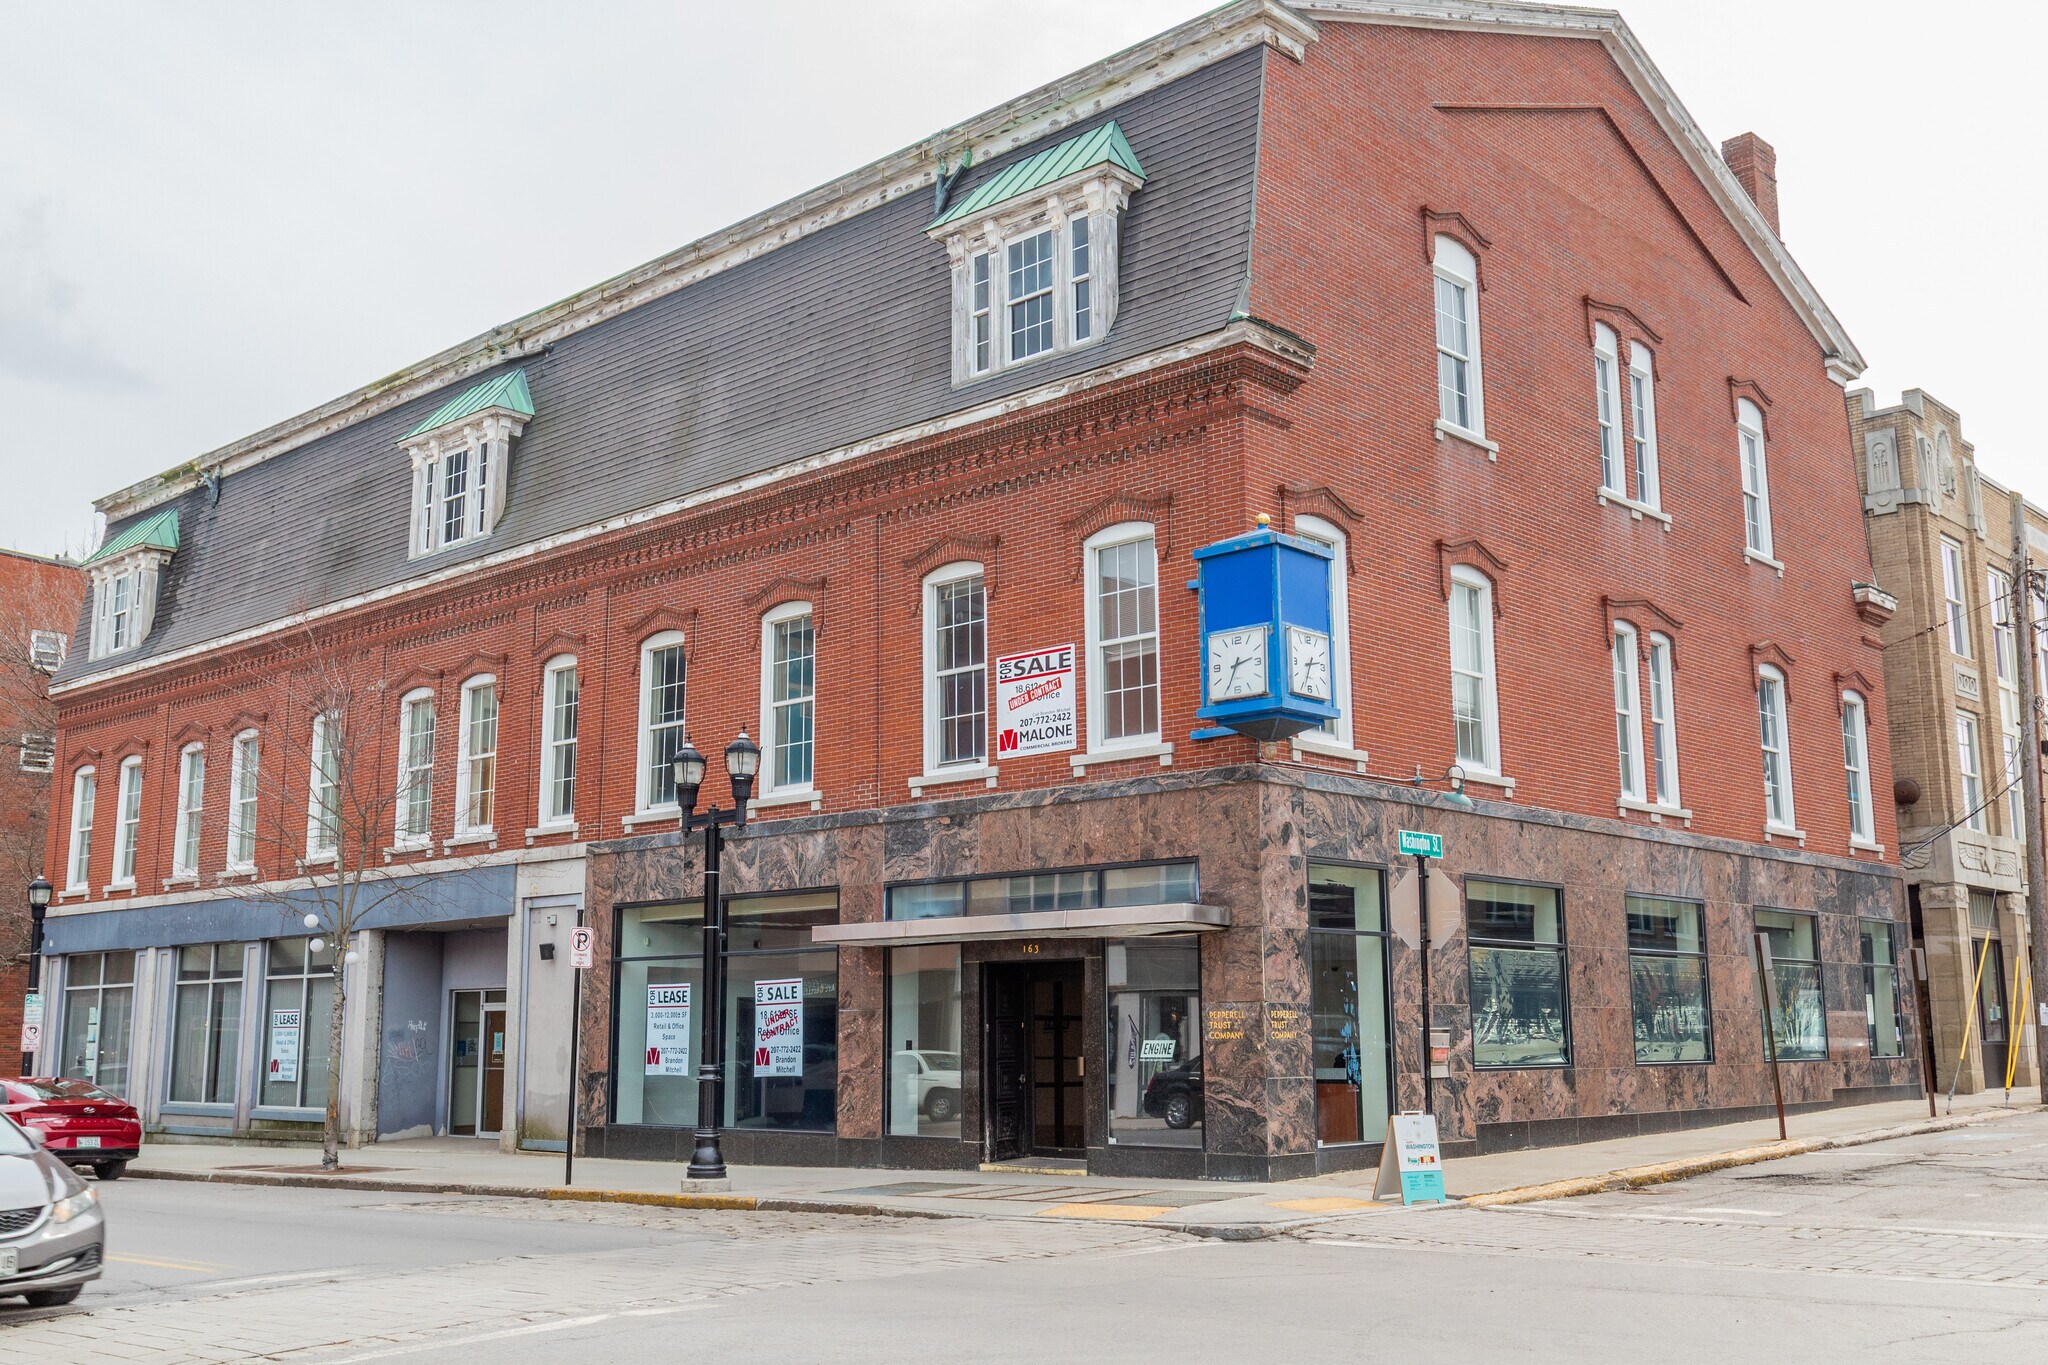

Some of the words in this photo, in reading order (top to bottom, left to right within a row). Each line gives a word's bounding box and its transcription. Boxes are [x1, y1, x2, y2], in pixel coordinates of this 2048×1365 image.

[1232, 636, 1242, 645] 12
[1014, 652, 1071, 677] SALE
[1254, 657, 1261, 666] 3
[1000, 661, 1012, 680] FOR
[1214, 664, 1220, 672] 9
[1320, 664, 1326, 672] 3
[1009, 692, 1029, 709] UNDER
[1030, 680, 1060, 700] CONTRACT
[1234, 686, 1242, 694] 6
[1307, 685, 1313, 693] 6
[1020, 712, 1071, 727] 207-772-2422
[1020, 724, 1072, 742] MALONE
[1020, 743, 1050, 751] COMMERCIAL
[1402, 832, 1430, 854] Washington
[1024, 944, 1038, 953] 163
[658, 991, 687, 1003] LEASE
[768, 986, 797, 1000] SALE
[280, 1014, 298, 1024] LEASE
[765, 1009, 789, 1027] UNDER
[761, 1016, 798, 1041] CONTRACT
[1143, 1043, 1173, 1054] ENGINE
